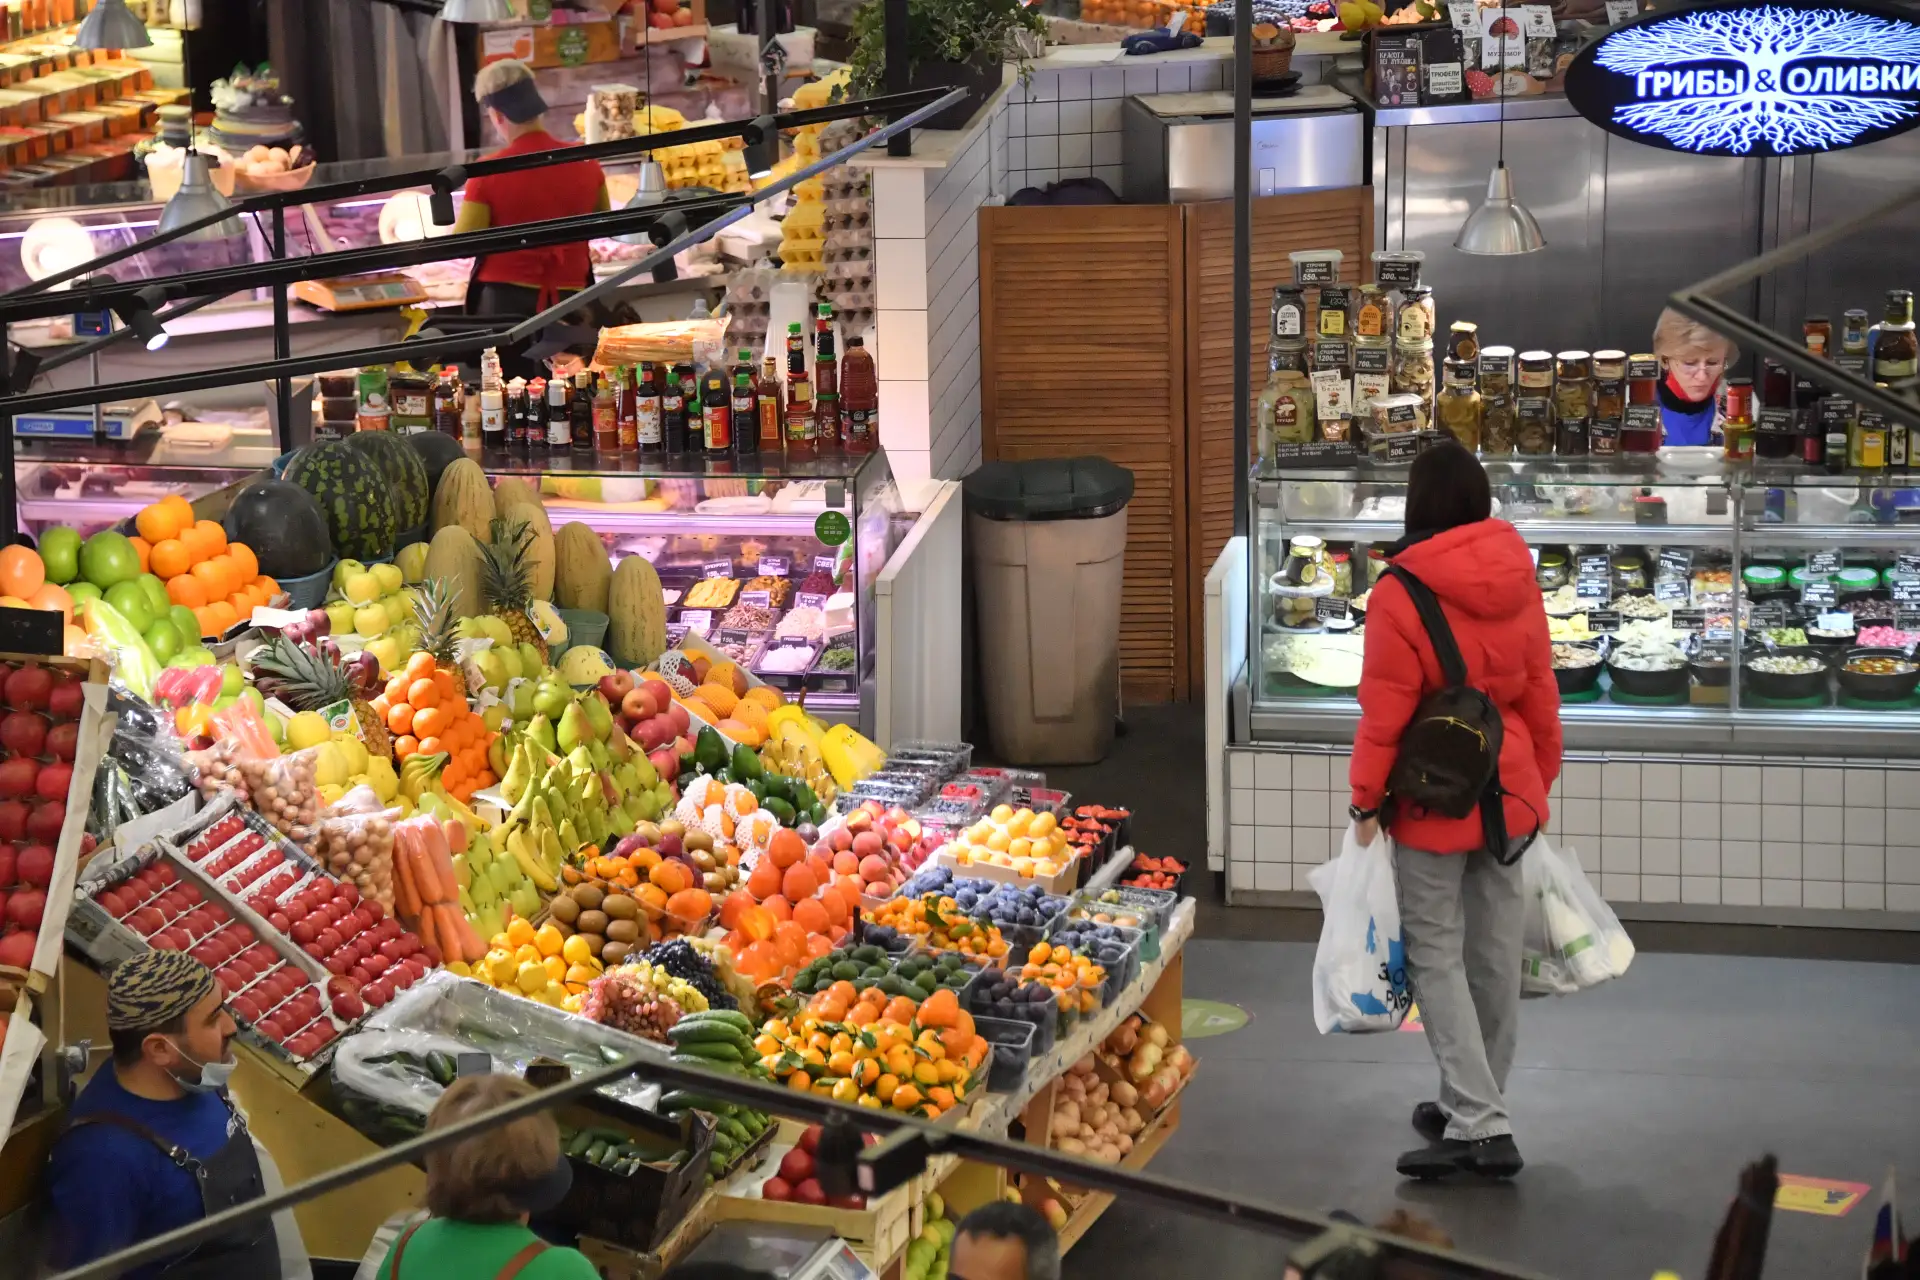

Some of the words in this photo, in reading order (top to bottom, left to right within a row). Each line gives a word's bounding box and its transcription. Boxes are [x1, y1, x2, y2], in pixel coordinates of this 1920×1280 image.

[1431, 70, 1460, 78] ТРЮФЕЛИ
[1637, 69, 1744, 98] ГРИБЫ
[1754, 68, 1777, 94] &
[1786, 65, 1920, 93] ОЛИВКИ
